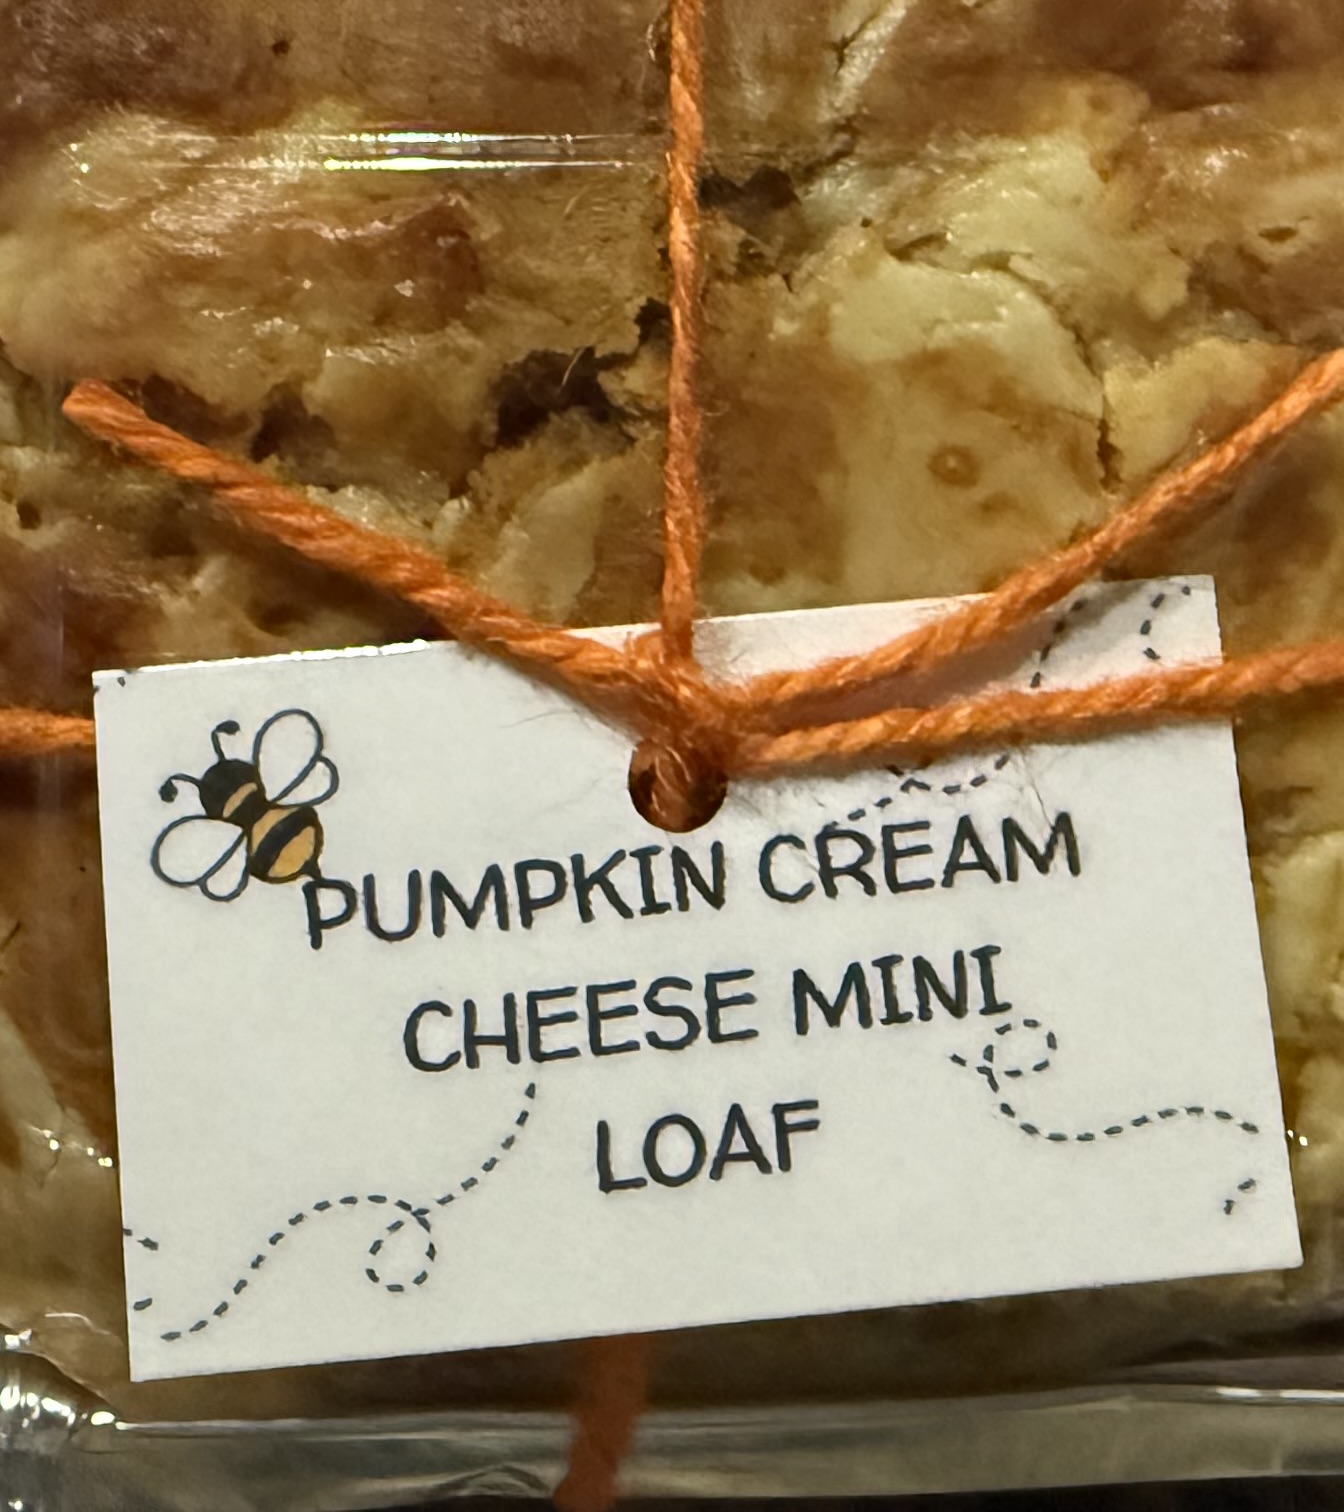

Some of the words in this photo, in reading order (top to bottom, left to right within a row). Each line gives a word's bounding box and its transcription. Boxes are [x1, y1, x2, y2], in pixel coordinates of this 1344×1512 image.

[303, 840, 726, 951] PUMPKIN
[758, 811, 1082, 904] CREAM
[402, 969, 760, 1074] CHEESE
[792, 944, 1014, 1037] MINI
[596, 1099, 821, 1196] LOAF
